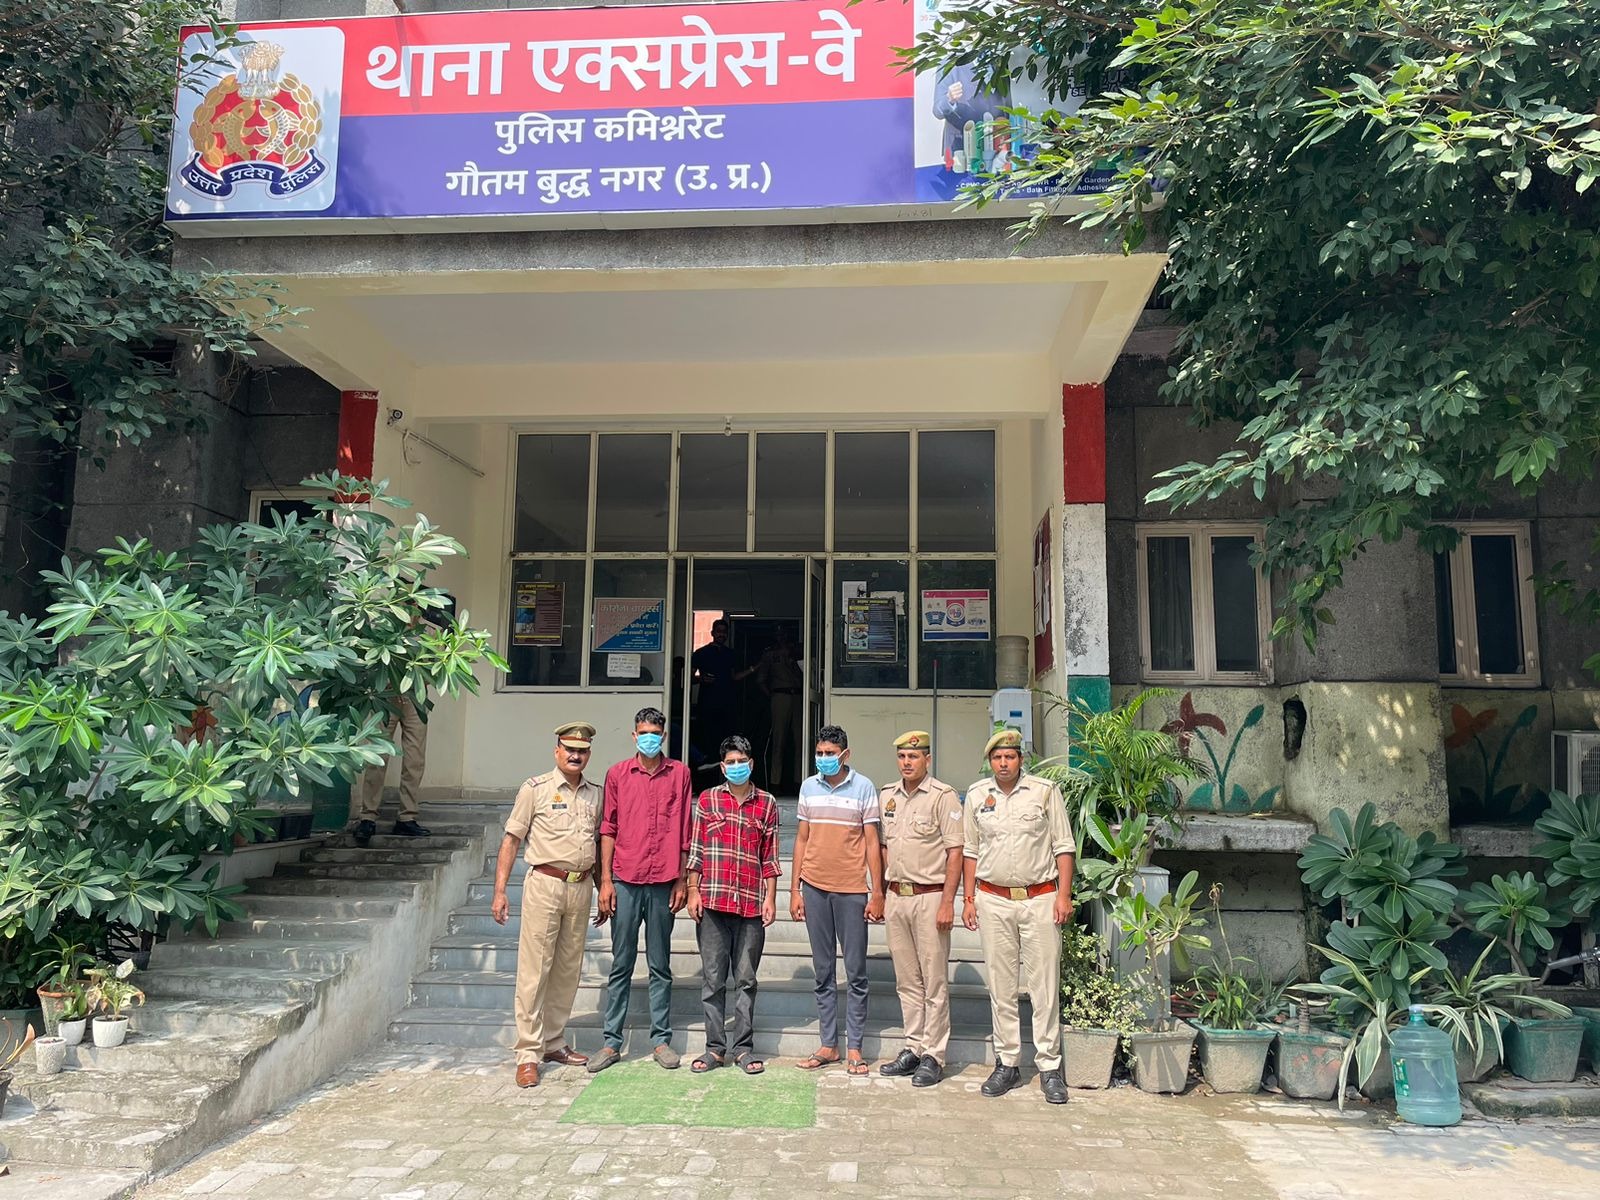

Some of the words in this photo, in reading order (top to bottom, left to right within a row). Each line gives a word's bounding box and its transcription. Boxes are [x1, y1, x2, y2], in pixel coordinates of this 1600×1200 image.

[366, 42, 511, 98] थाना
[527, 10, 863, 93] एक्सप्रेस-वे
[495, 112, 585, 155] पुलिस
[188, 169, 221, 193] उत्तर
[229, 164, 274, 180] प्रदेश
[279, 162, 321, 192] पुलिस
[446, 161, 529, 196] गौतम
[536, 167, 593, 204] बुद्ध
[600, 166, 666, 193] नगर
[1084, 176, 1110, 184] Garden
